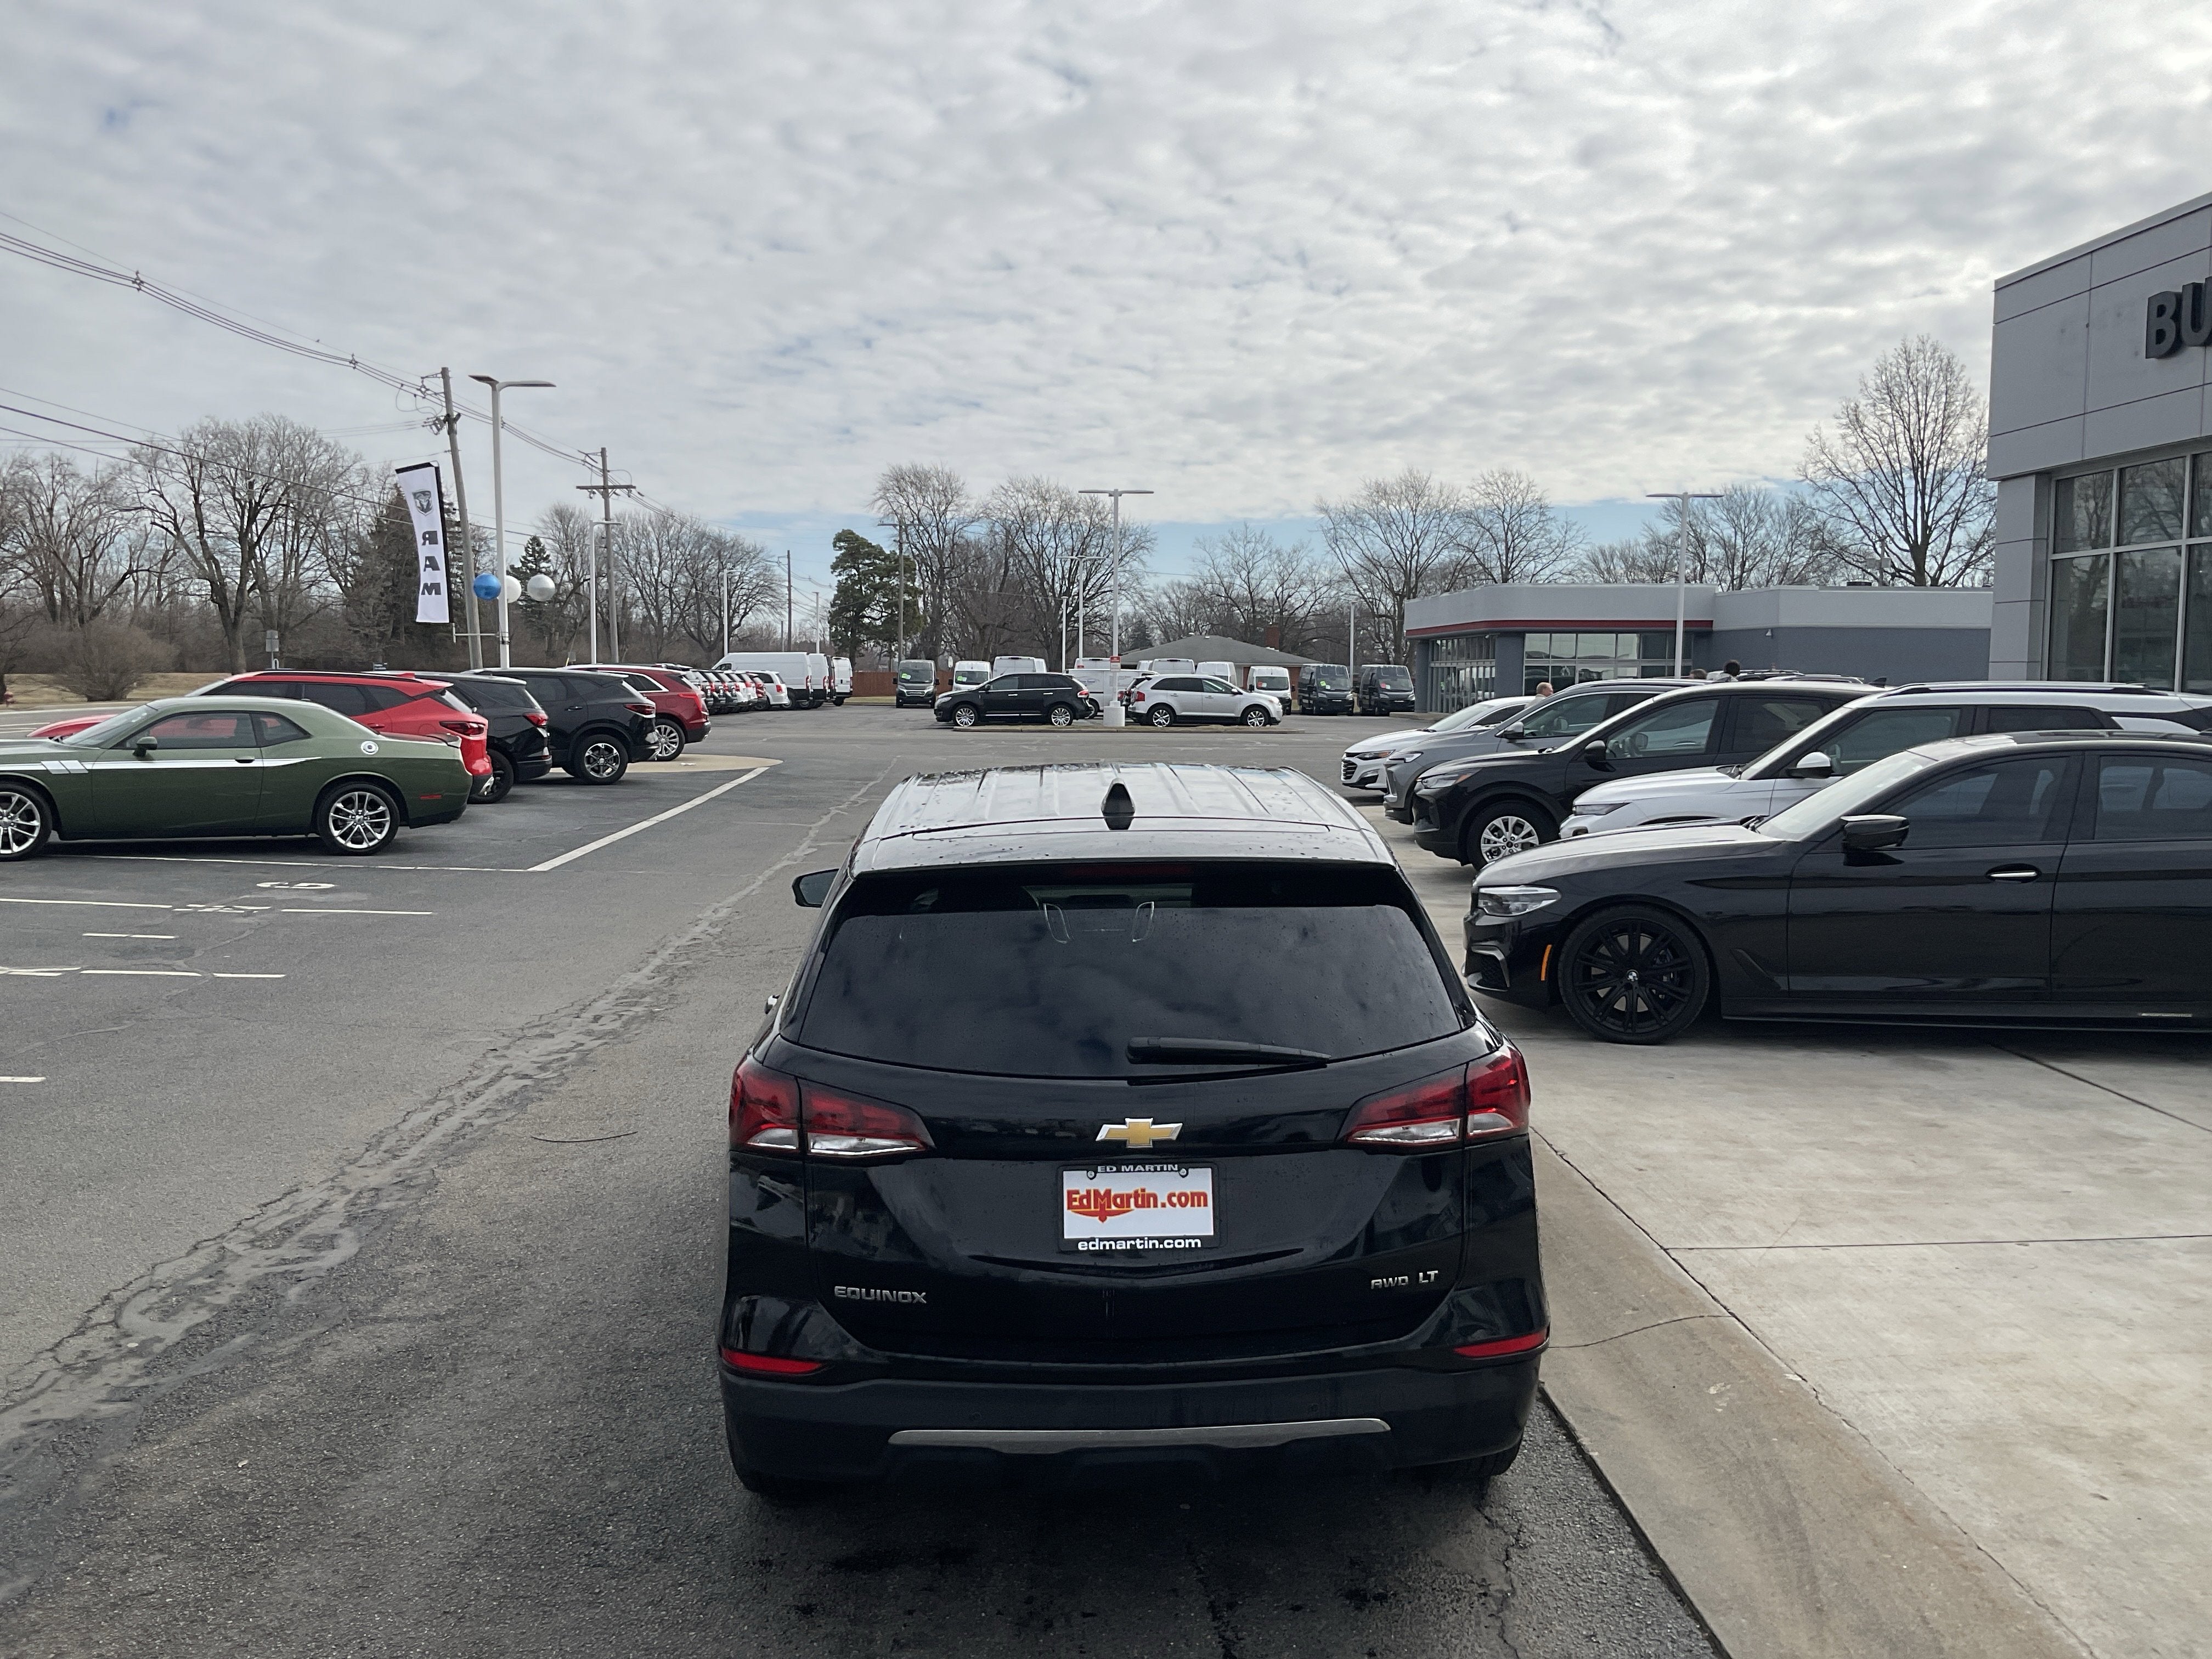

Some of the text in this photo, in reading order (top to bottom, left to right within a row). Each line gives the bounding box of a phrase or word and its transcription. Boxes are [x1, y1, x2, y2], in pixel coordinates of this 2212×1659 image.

[2146, 276, 2212, 359] BU
[1121, 1164, 1178, 1172] MARTIN
[1066, 1187, 1208, 1211] EdMartin.com
[1077, 1237, 1201, 1251] edmartin.com
[1370, 1270, 1438, 1290] AWD LT
[834, 1286, 927, 1304] EQUINOX
